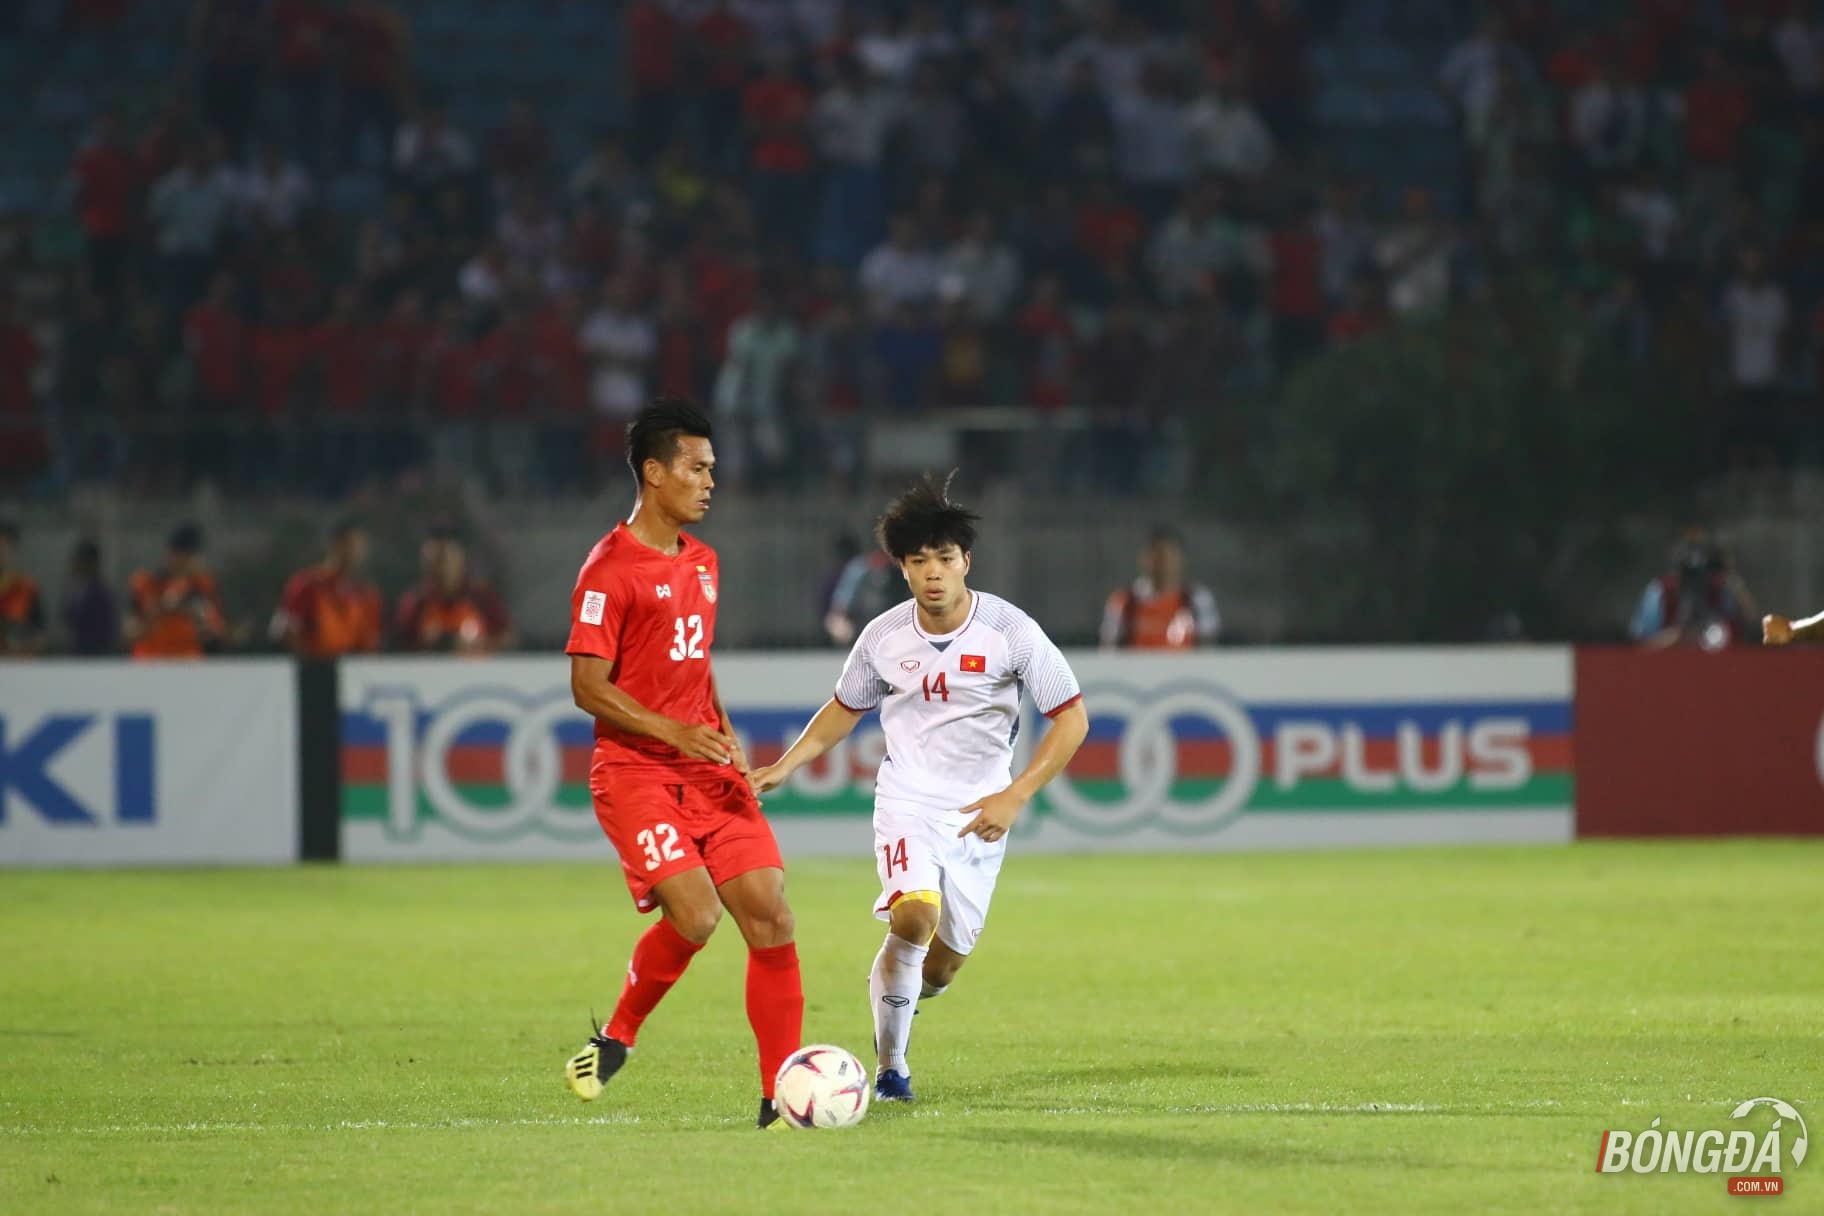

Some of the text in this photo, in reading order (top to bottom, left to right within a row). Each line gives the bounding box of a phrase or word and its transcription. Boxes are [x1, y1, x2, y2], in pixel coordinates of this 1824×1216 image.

[669, 614, 704, 661] 32
[922, 671, 949, 702] 14
[1275, 718, 1532, 791] PLUS
[636, 823, 686, 871] 32
[883, 837, 909, 879] 14
